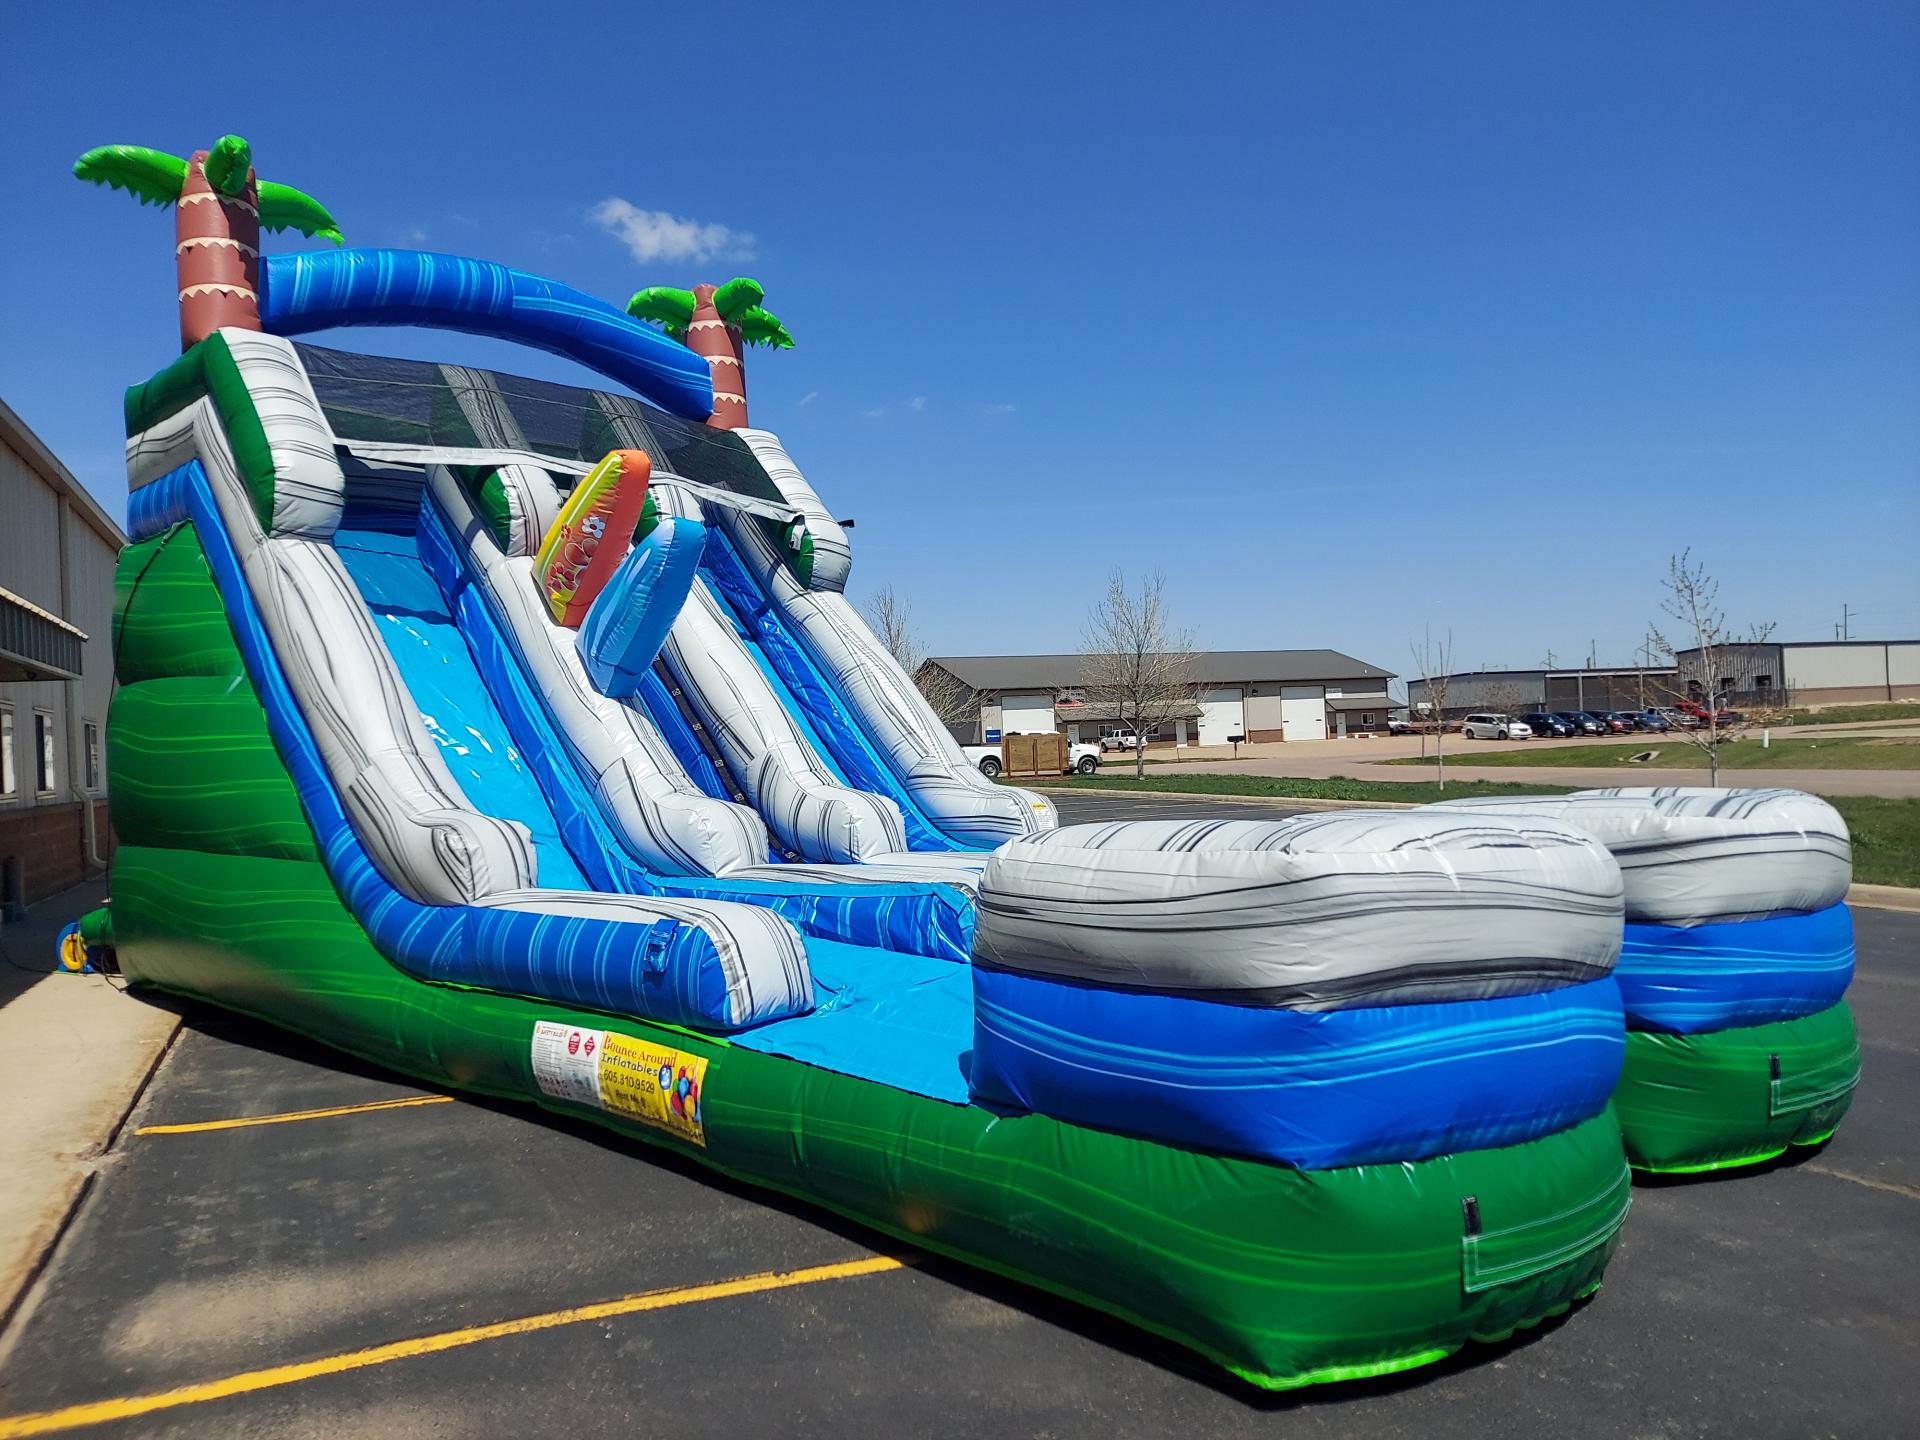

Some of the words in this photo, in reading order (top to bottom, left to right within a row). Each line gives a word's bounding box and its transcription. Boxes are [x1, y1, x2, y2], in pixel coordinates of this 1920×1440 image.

[603, 1034, 637, 1058] Bounce
[639, 1050, 678, 1068] Around
[601, 1052, 658, 1077] Inflatables
[603, 1069, 655, 1094] 605.310.9529
